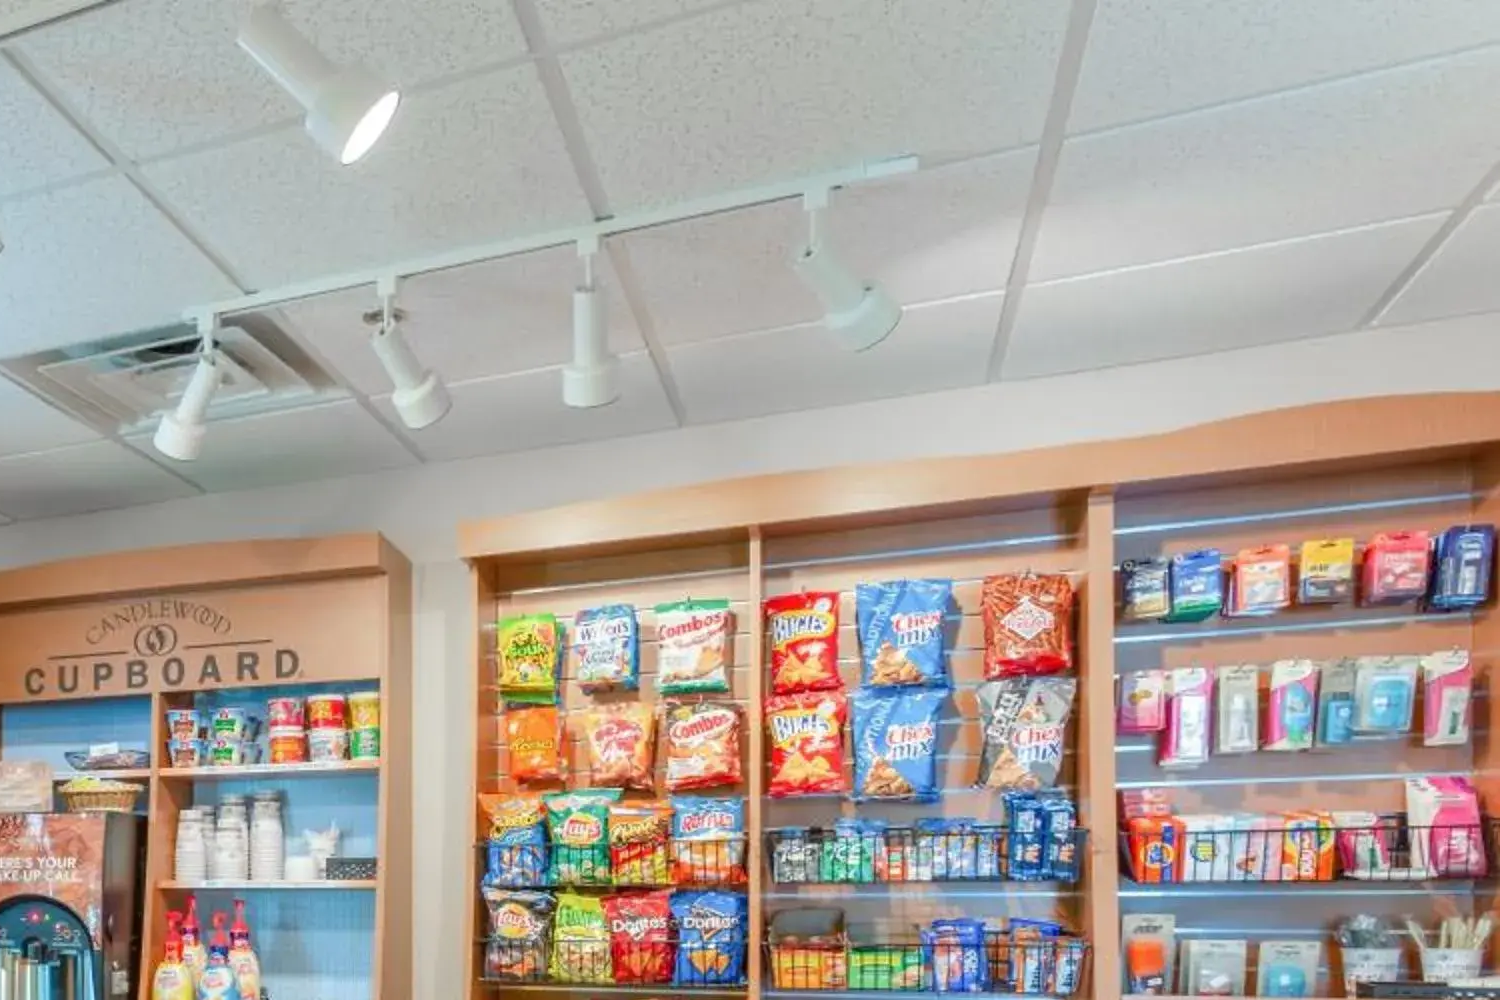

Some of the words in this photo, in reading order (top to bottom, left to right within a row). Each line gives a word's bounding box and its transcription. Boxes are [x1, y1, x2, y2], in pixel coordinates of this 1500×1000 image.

[85, 599, 233, 645] CANDLEWOOD
[659, 611, 726, 640] Combos
[893, 612, 942, 633] Chex
[898, 627, 937, 645] mix
[24, 648, 301, 696] CUPBOARD
[672, 713, 730, 739] Combos
[886, 725, 933, 746] Chex
[1014, 726, 1060, 748] Chex
[890, 742, 930, 760] mix
[1018, 743, 1060, 762] mix
[37, 856, 77, 869] YOUR
[612, 917, 668, 933] Doritos
